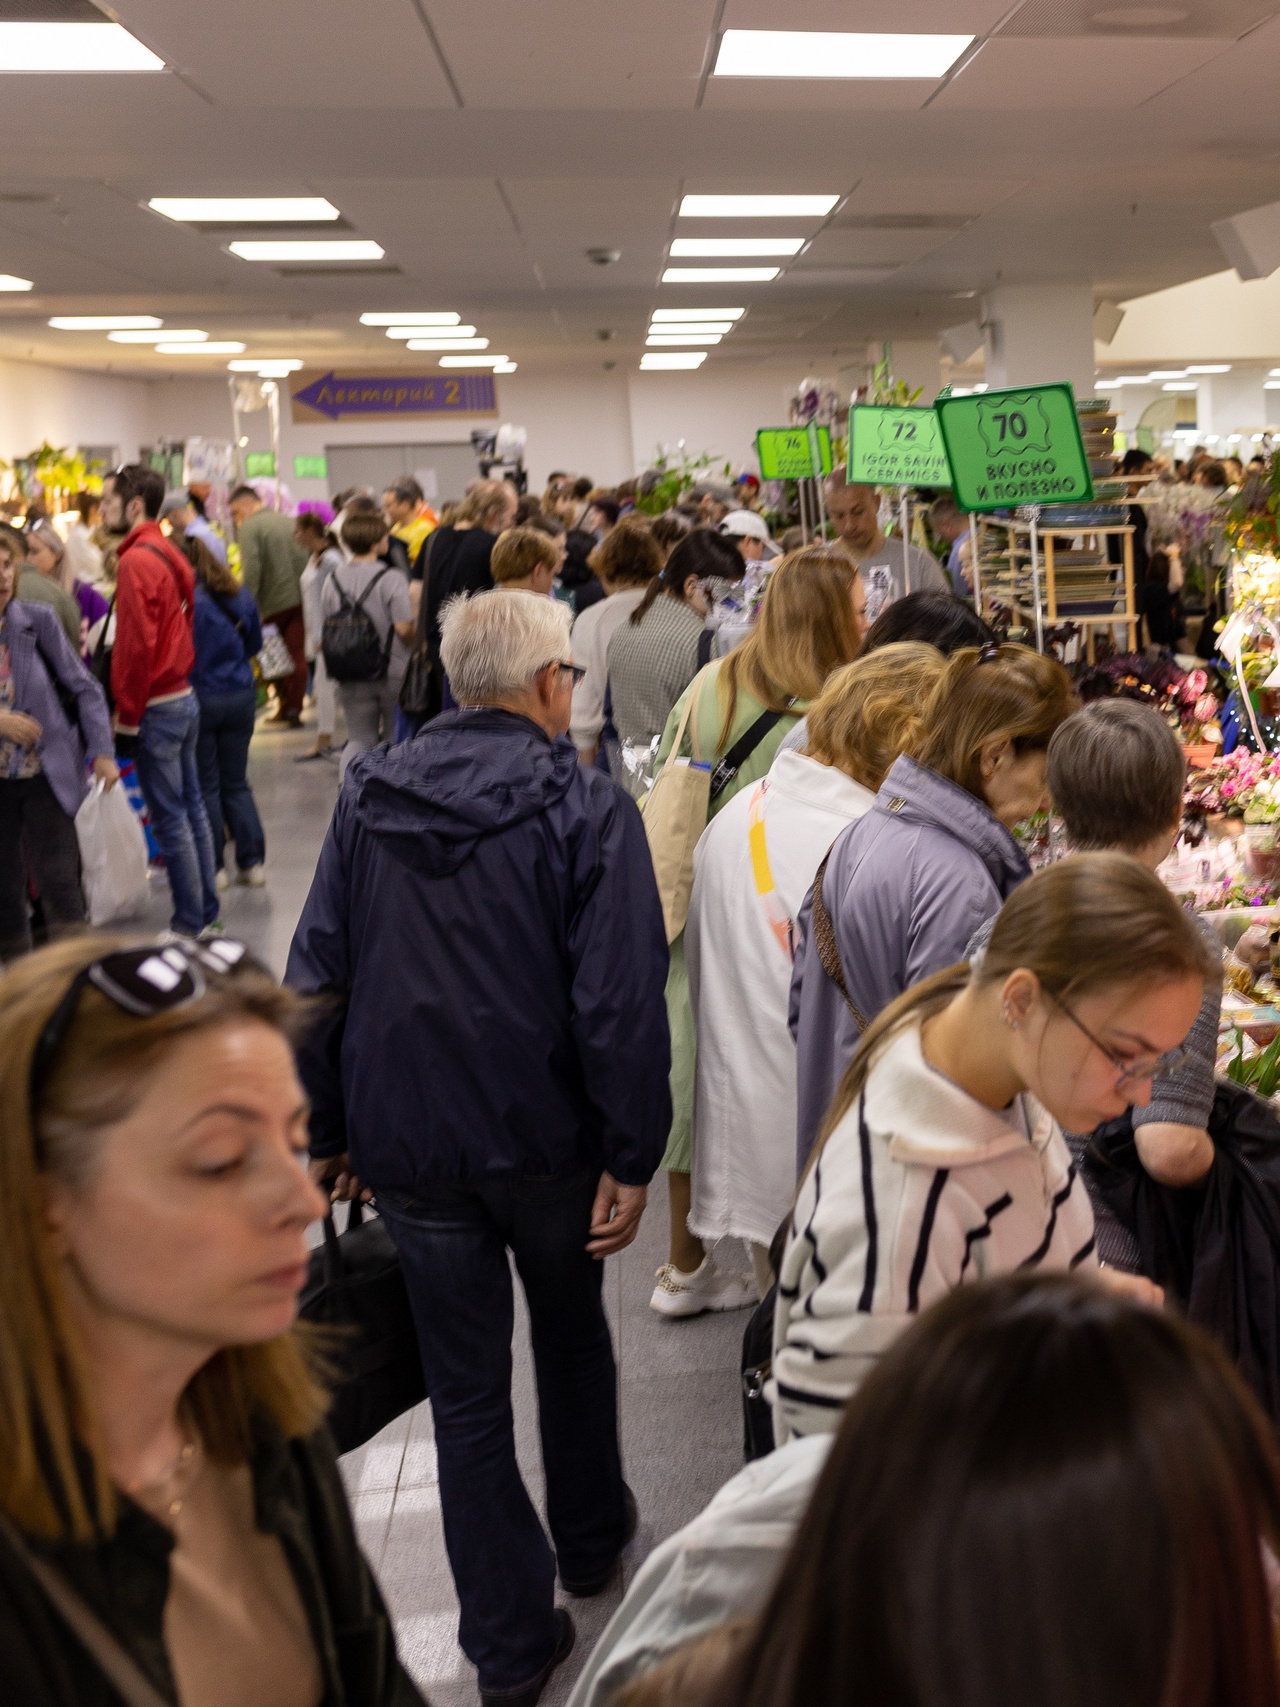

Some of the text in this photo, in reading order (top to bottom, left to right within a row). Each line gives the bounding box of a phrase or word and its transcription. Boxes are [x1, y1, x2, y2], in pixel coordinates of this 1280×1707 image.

[316, 380, 460, 409] Лекторий 2
[892, 422, 918, 441] 72
[992, 411, 1027, 442] 70
[862, 452, 898, 466] IGOR
[986, 457, 1057, 481] ВКУСНО
[866, 466, 940, 481] CERAMICS
[976, 475, 1076, 501] И ПОЛЕЗНО
